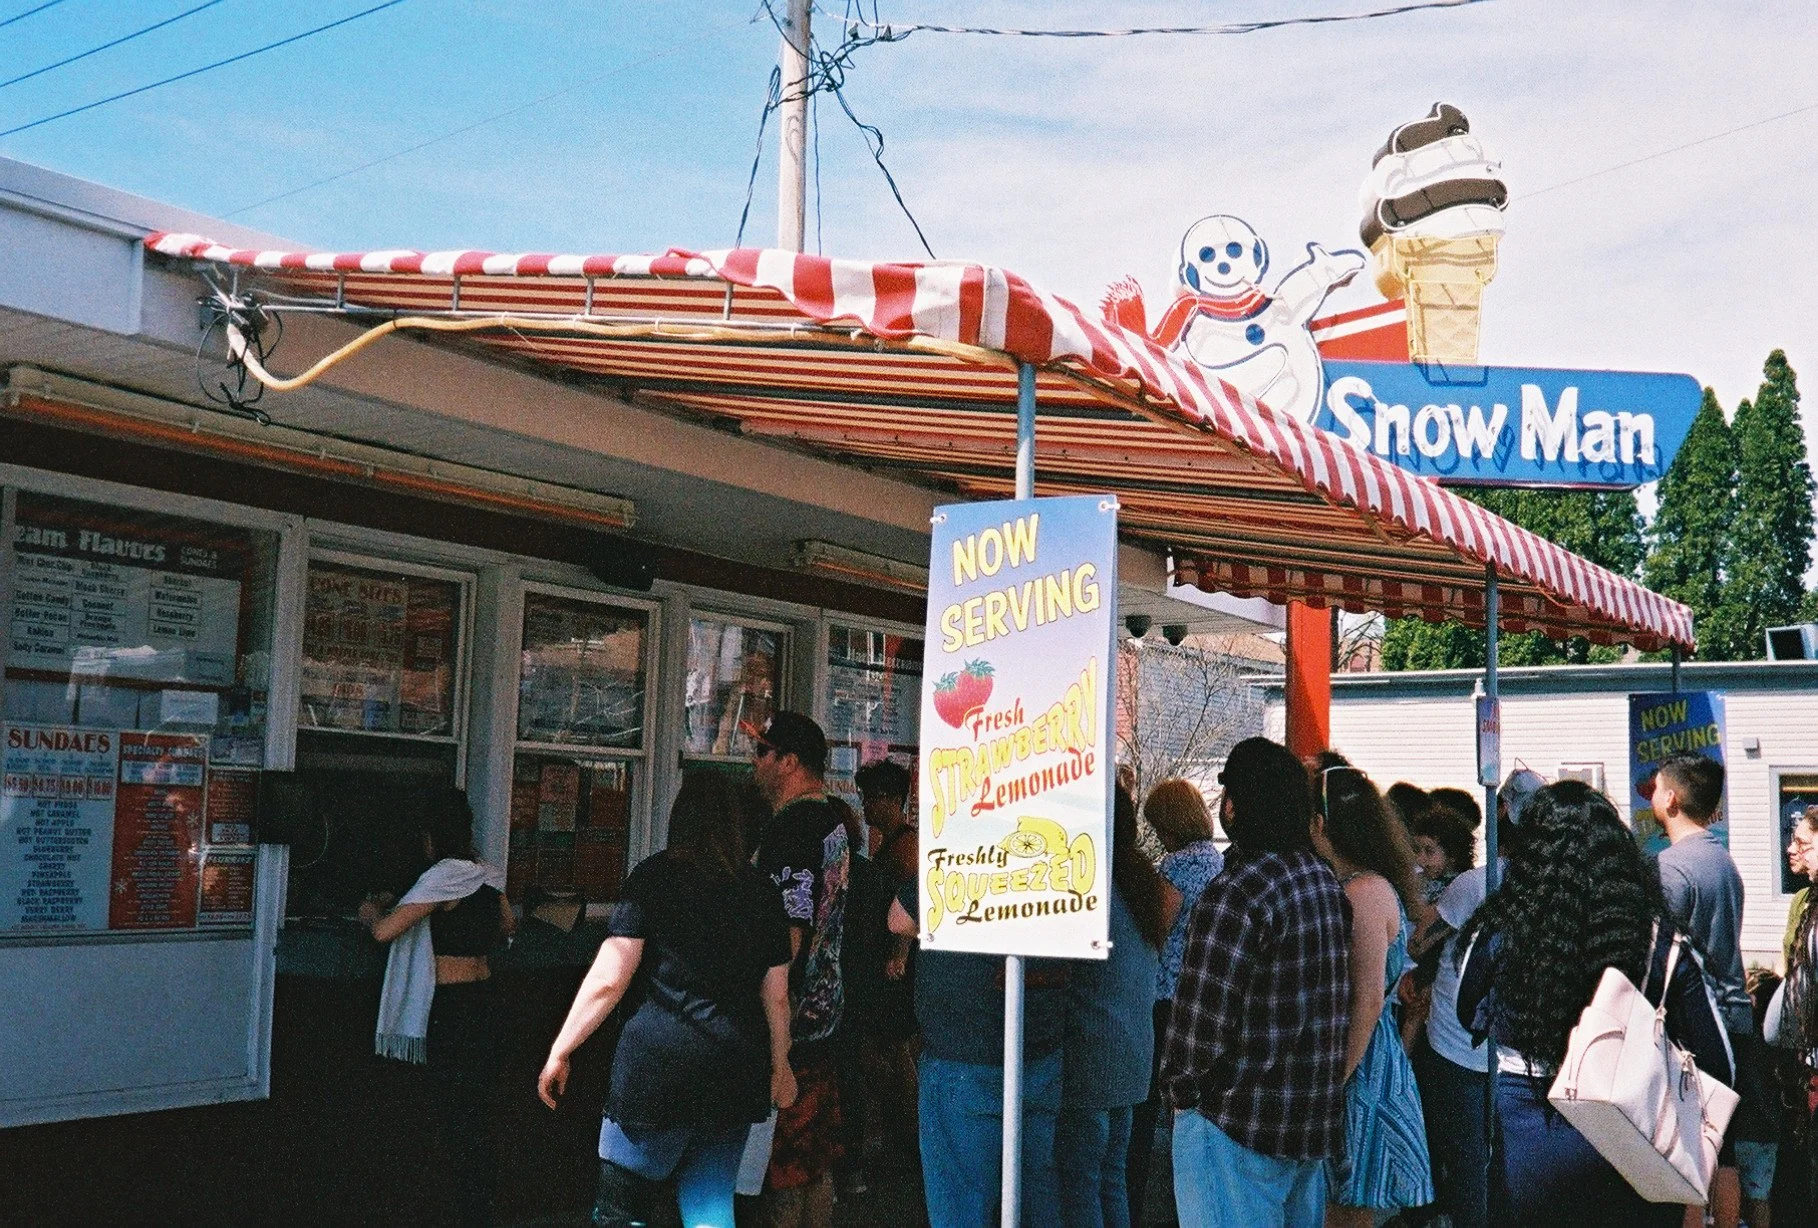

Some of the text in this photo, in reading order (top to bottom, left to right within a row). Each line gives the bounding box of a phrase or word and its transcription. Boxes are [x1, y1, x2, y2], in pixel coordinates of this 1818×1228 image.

[1326, 376, 1656, 465] Snow Man
[80, 530, 167, 563] Flavors
[953, 513, 1039, 587] NOW
[940, 562, 1100, 653] SERVING
[964, 697, 1024, 742] Fresh
[1641, 700, 1687, 732] NOW
[8, 728, 111, 754] SUNDAES
[929, 656, 1097, 839] STRAWBERRY
[1636, 722, 1721, 763] SERVING
[971, 746, 1095, 817] Lemonade
[926, 832, 1097, 933] SQUEEZED
[927, 846, 1008, 874] Freshly
[956, 889, 1097, 924] Lemonade
